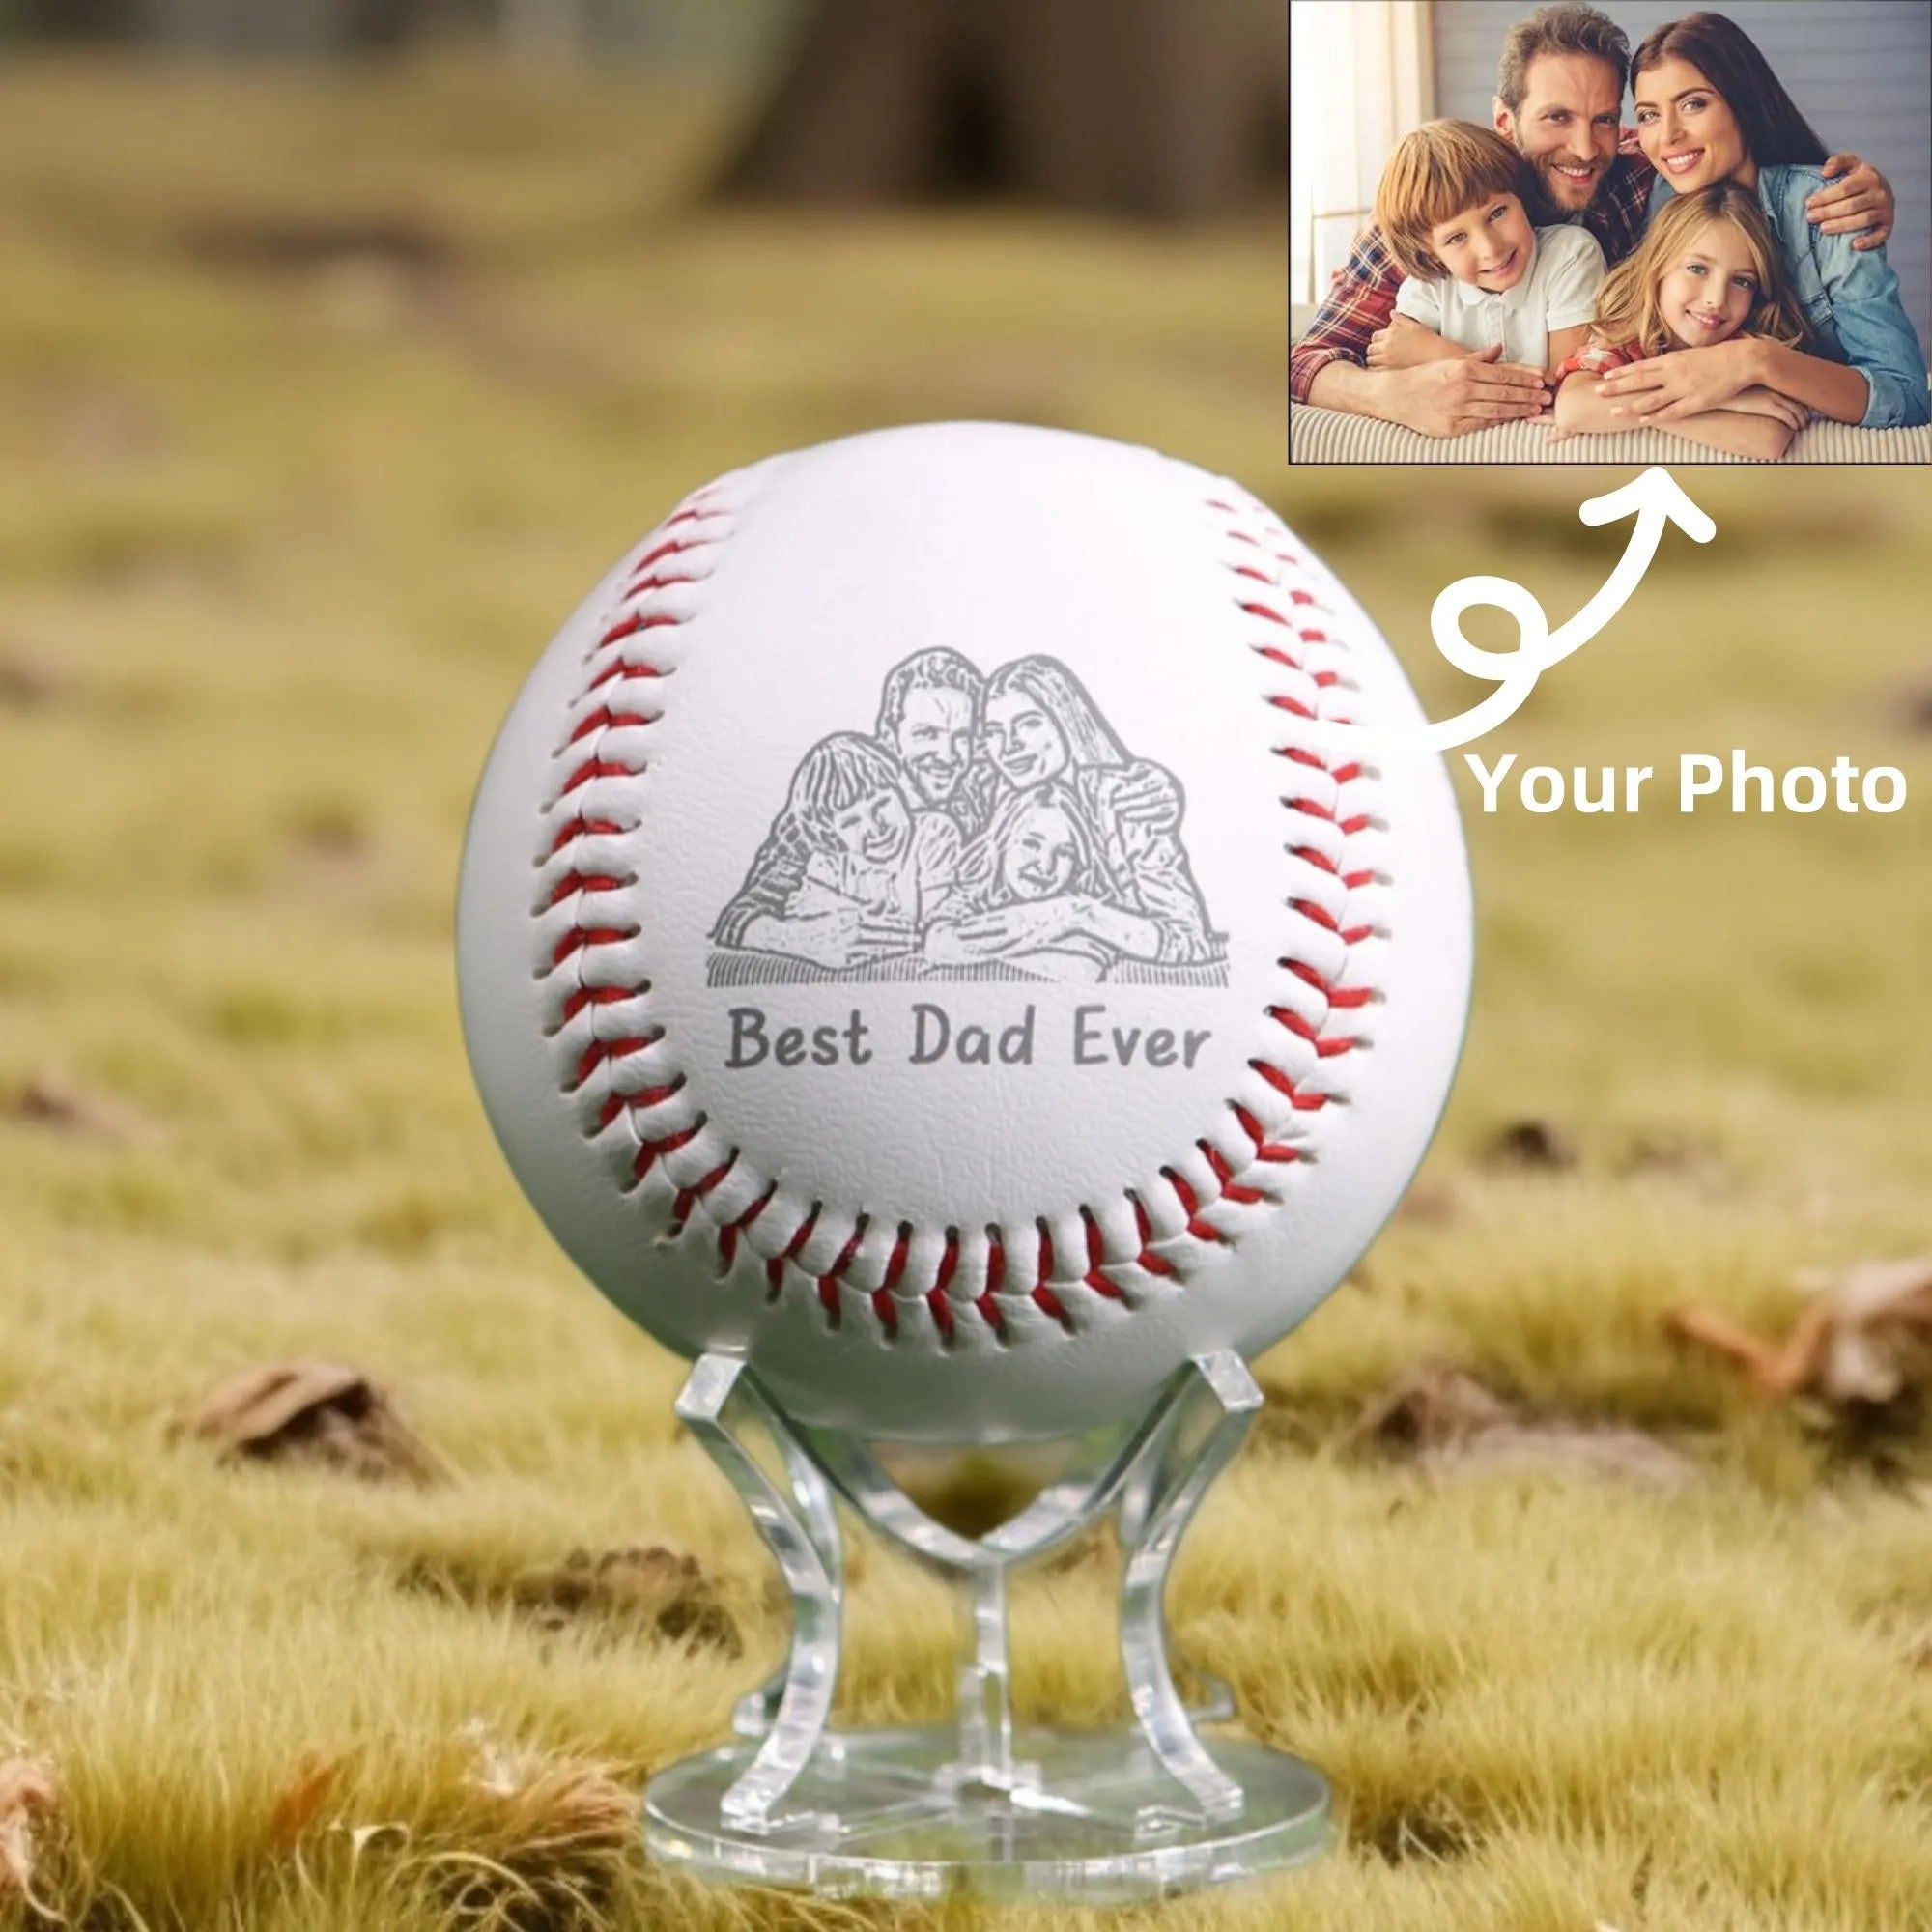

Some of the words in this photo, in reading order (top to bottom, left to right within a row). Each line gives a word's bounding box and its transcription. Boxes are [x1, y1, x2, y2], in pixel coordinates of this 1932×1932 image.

[724, 1007, 873, 1069] Best
[908, 1002, 1036, 1065] Dad
[1073, 1004, 1212, 1069] Ever
